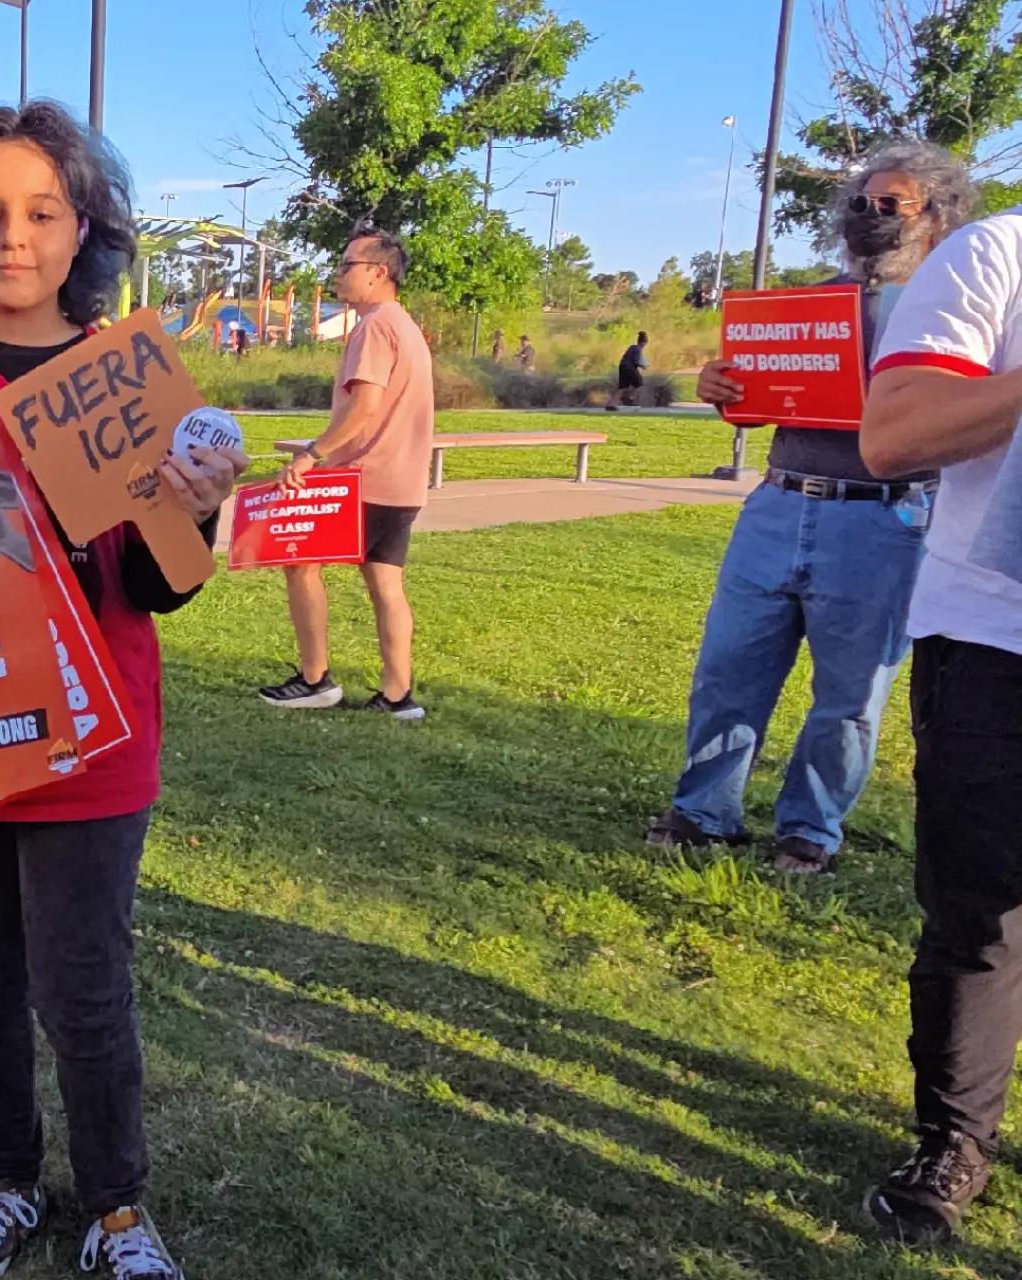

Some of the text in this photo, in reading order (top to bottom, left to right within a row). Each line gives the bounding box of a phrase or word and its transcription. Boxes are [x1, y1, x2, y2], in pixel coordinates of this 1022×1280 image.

[726, 321, 851, 341] SOLIDARITY HAS
[757, 353, 840, 372] BORDERS!
[11, 331, 173, 451] FUERA
[79, 396, 157, 473] ICE
[183, 416, 212, 441] ICE
[244, 496, 262, 507] WE
[297, 485, 349, 499] AFFORD
[248, 503, 342, 521] THE CAPITALIST
[269, 521, 315, 535] CLASS!
